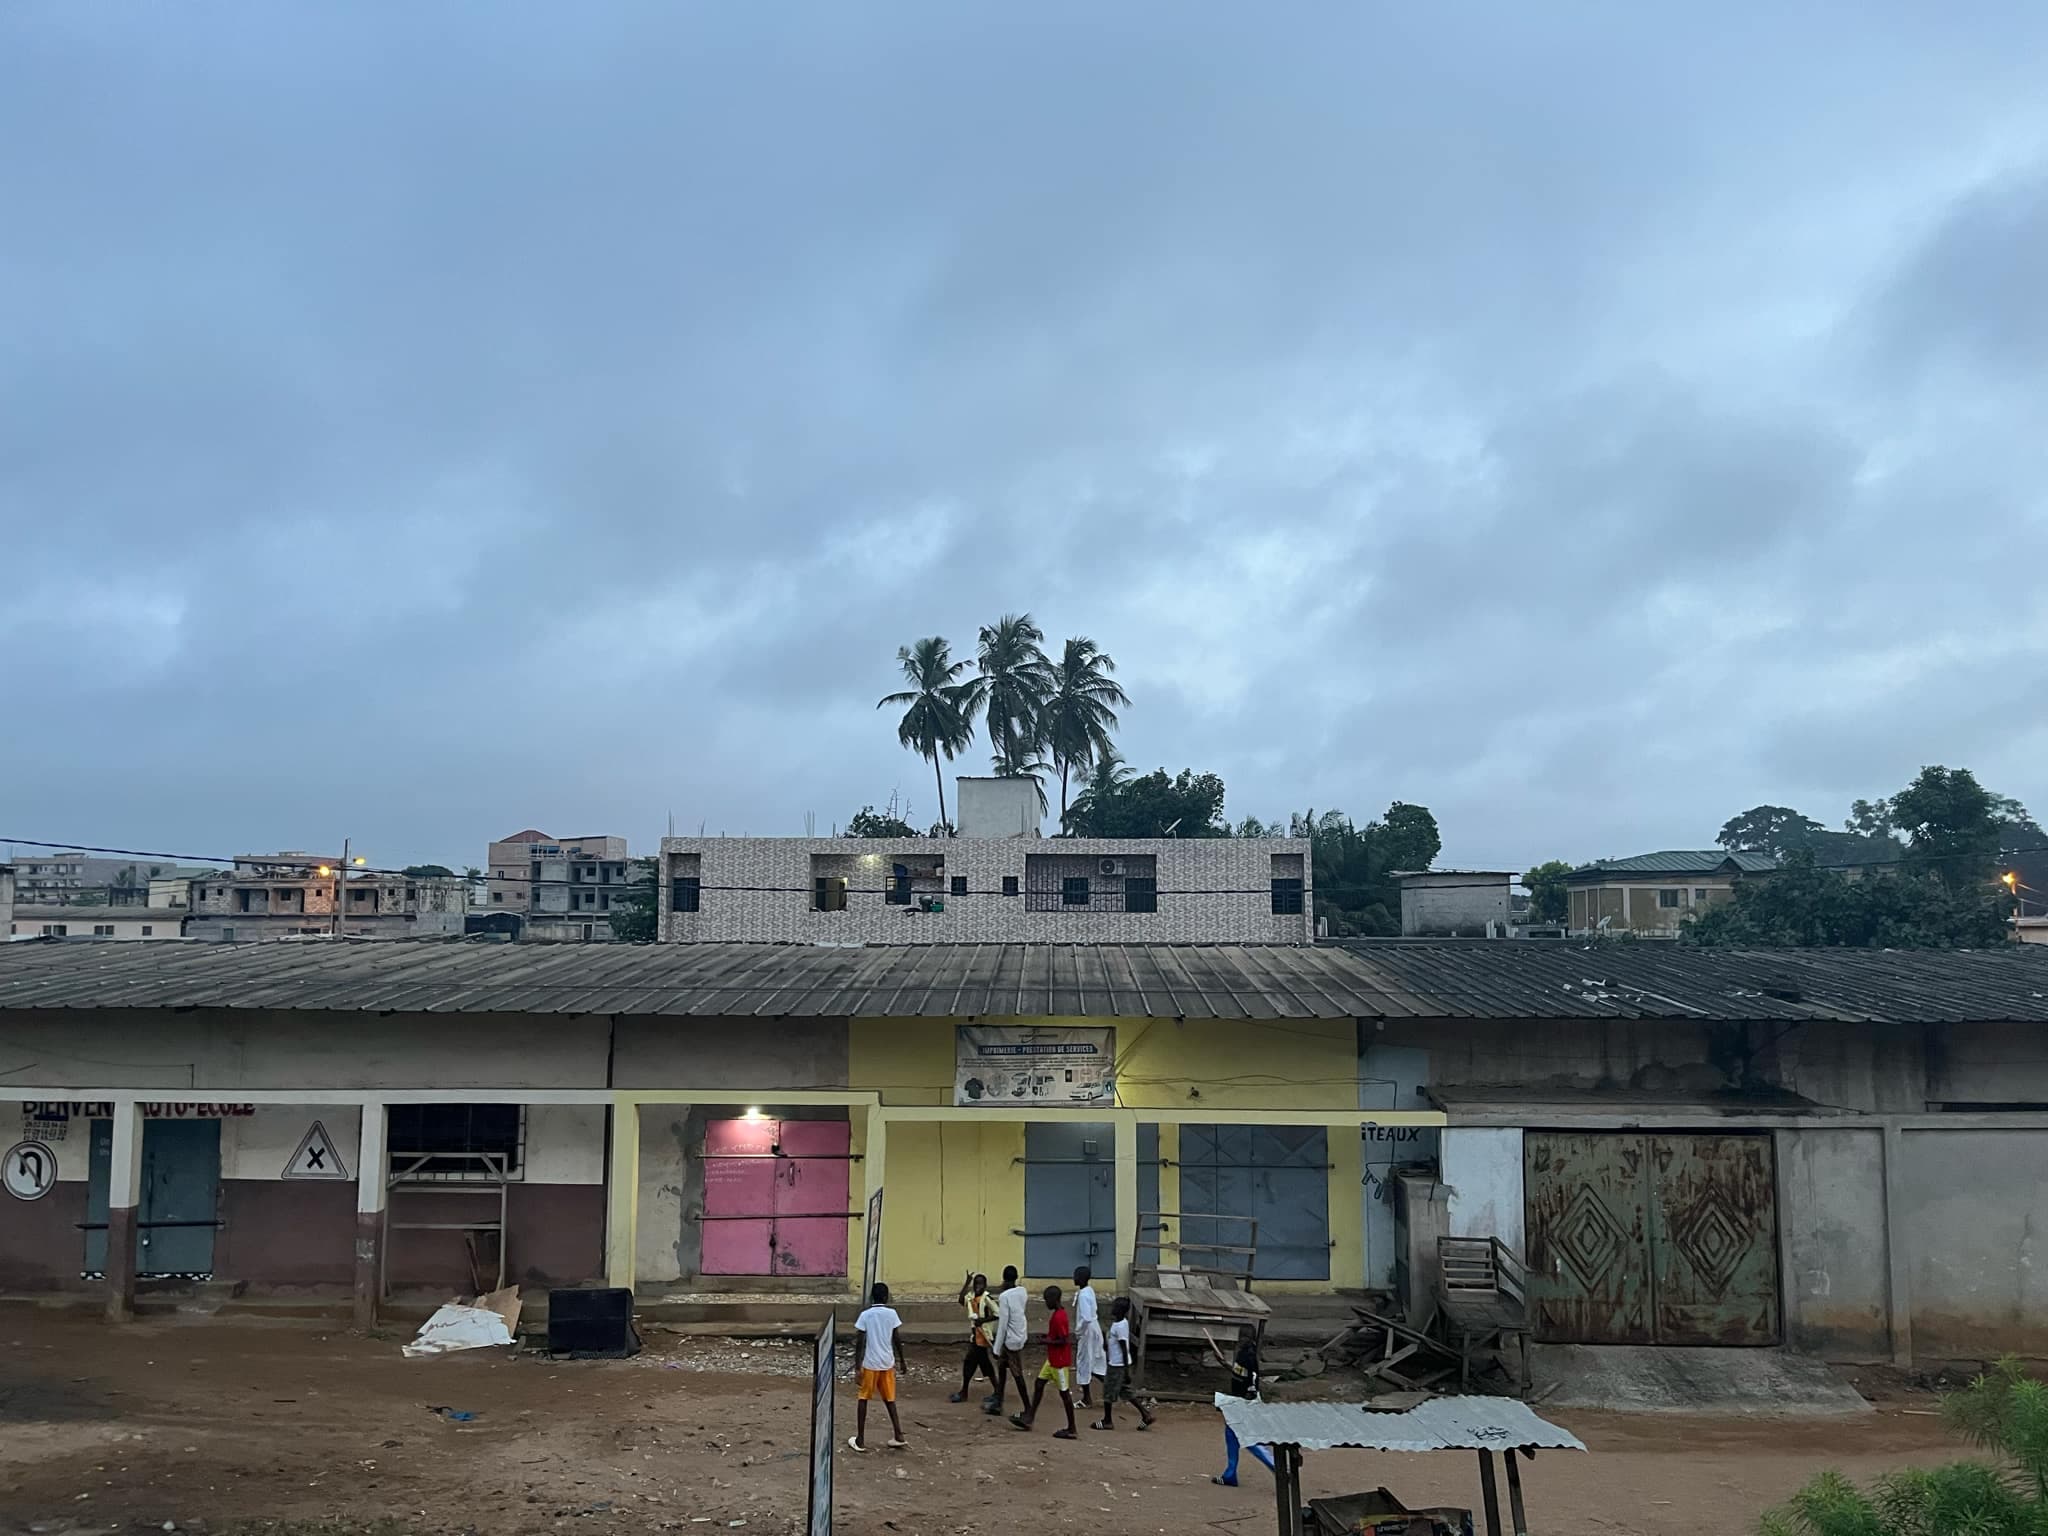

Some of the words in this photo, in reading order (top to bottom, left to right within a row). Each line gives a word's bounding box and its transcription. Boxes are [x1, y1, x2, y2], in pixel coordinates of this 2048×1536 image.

[982, 1046, 1016, 1055] IMPRIMERIE
[1022, 1046, 1056, 1054] PRESTATION
[1066, 1045, 1093, 1053] SERVICES
